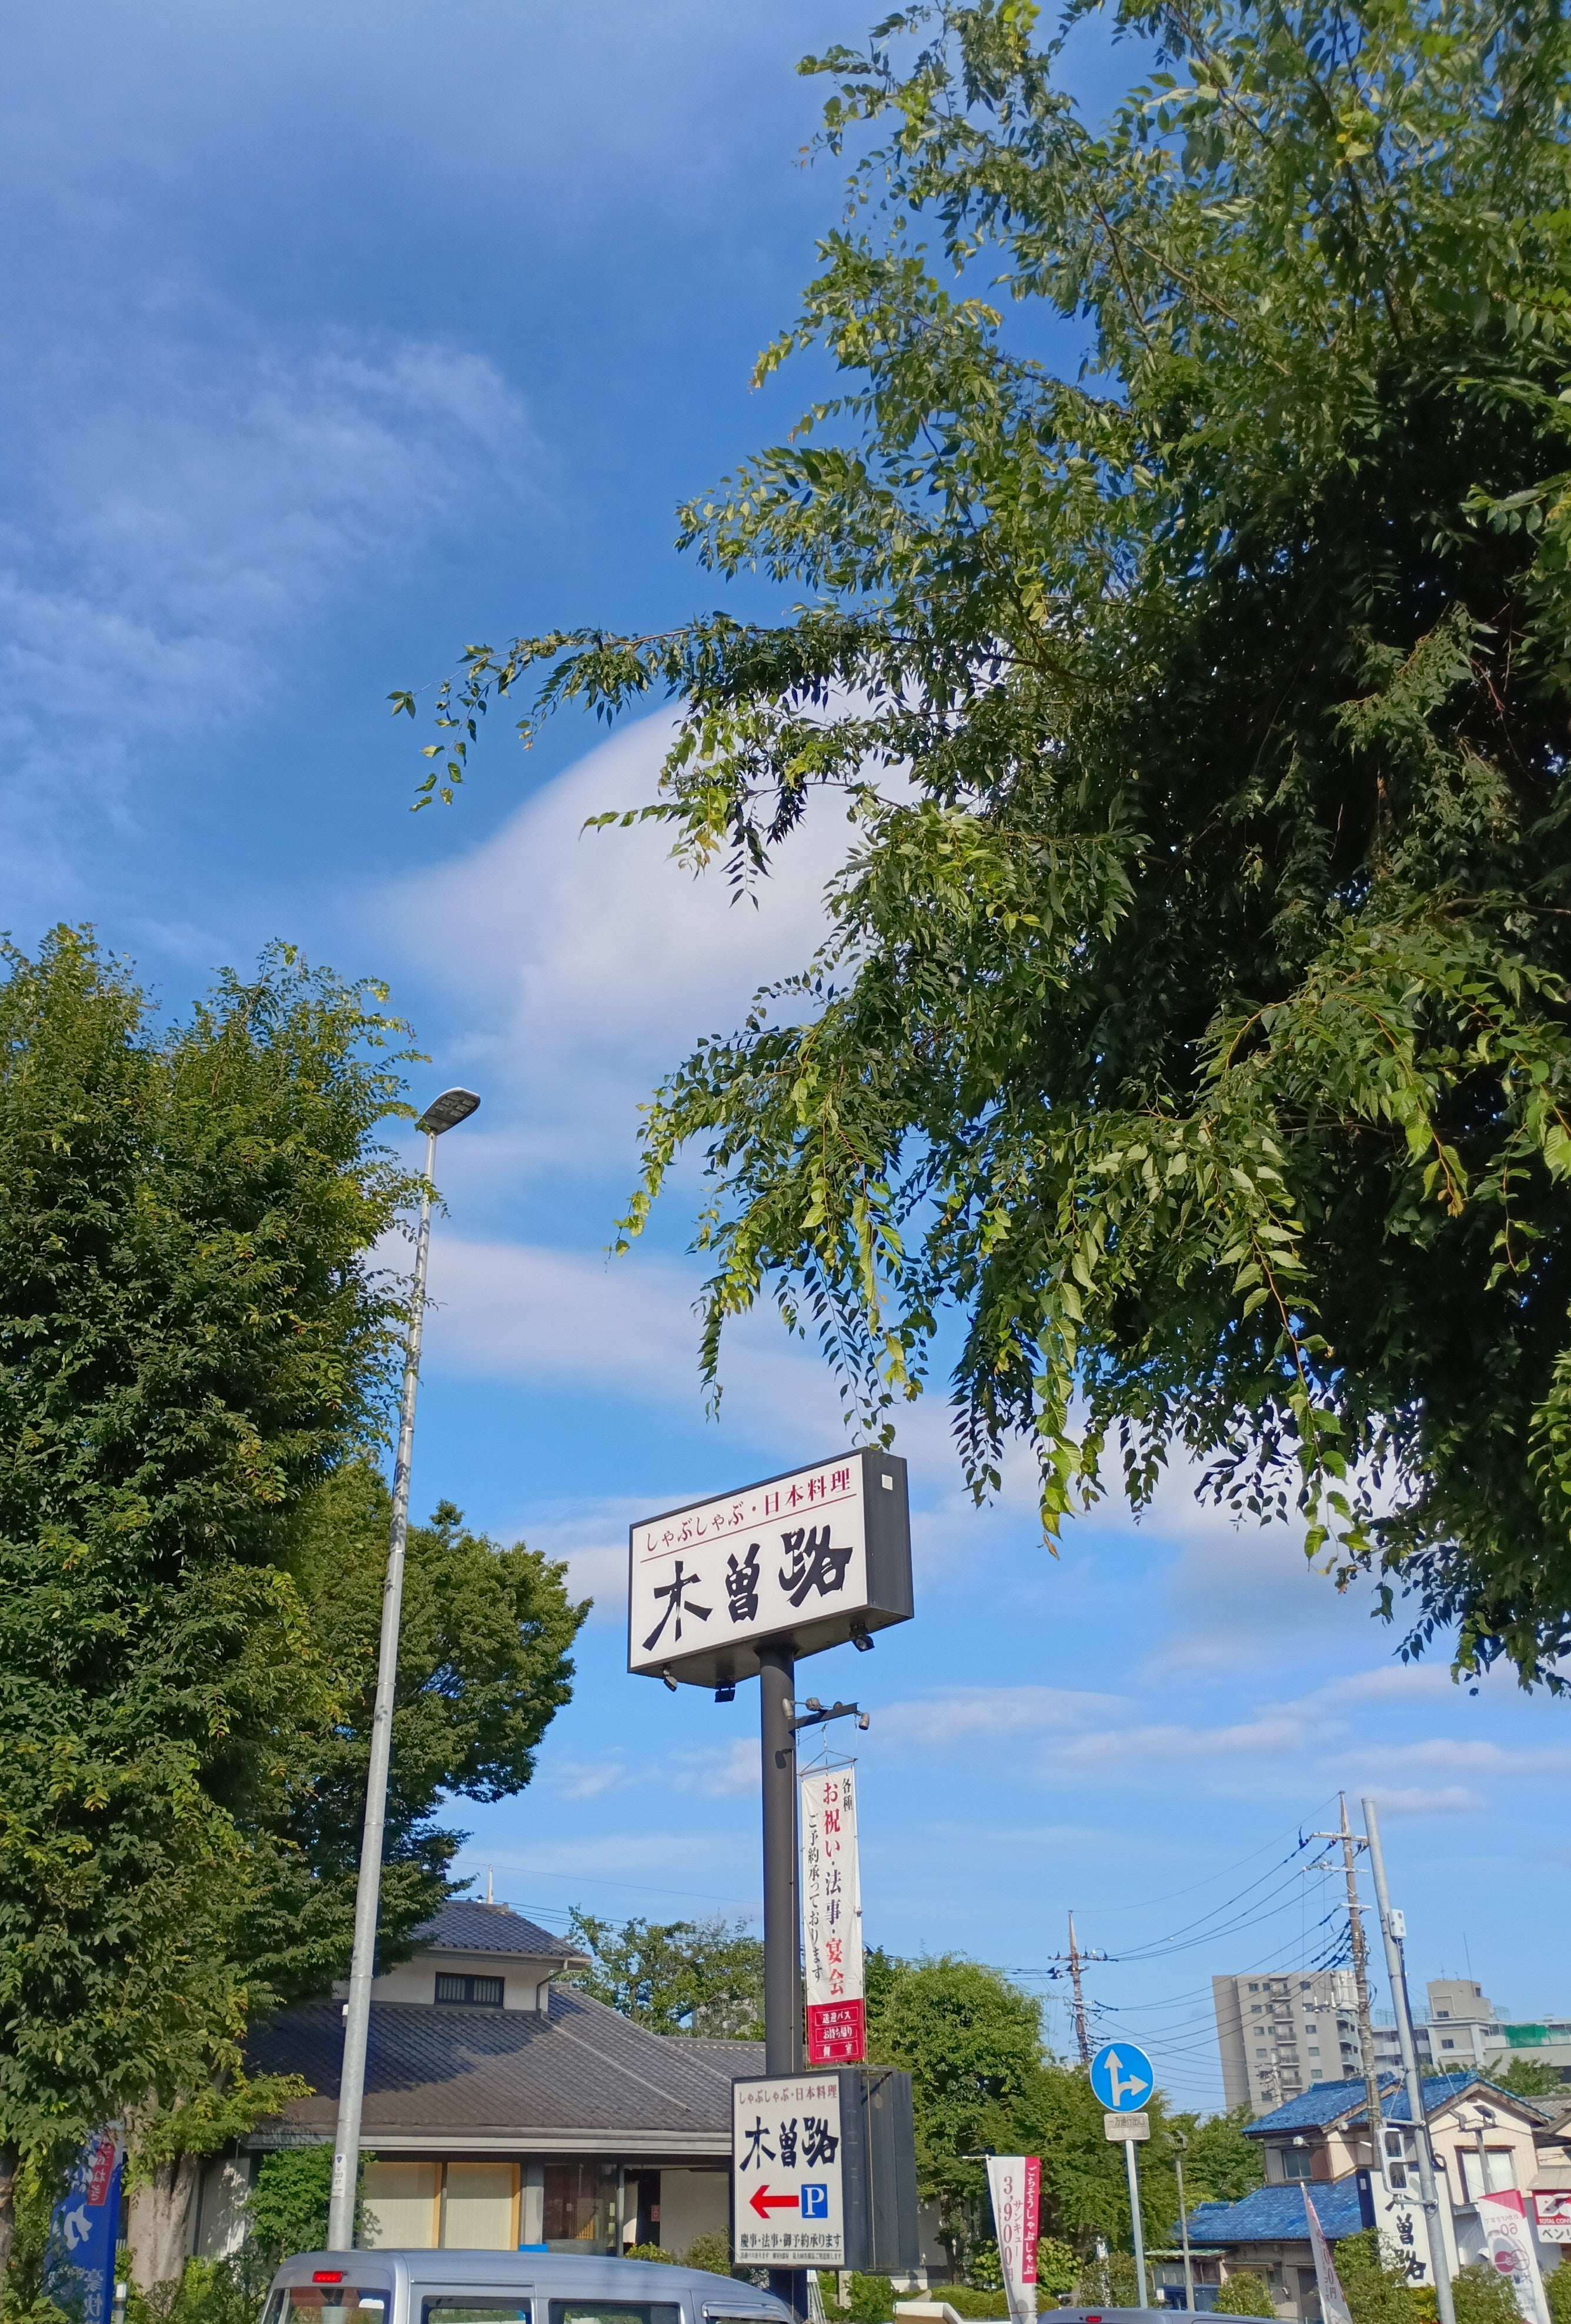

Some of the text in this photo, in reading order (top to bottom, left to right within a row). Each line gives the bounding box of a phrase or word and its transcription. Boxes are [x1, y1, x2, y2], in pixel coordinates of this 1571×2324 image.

[646, 1467, 850, 1552] しゃぶしゃぶ・日本料理
[642, 1524, 854, 1651] 木曽路
[843, 1778, 853, 1812] 各種
[808, 1813, 822, 1982] ご予約承っております
[823, 1782, 844, 1995] お祝い・法事・宴会
[739, 2084, 837, 2104] しゃぶしゃぶ・日本料理
[740, 2116, 839, 2171] 木曽路
[804, 2187, 824, 2215] P
[1014, 2201, 1024, 2257] サンキュー
[1024, 2166, 1037, 2275] ごちそうしゃぶしゃぶ
